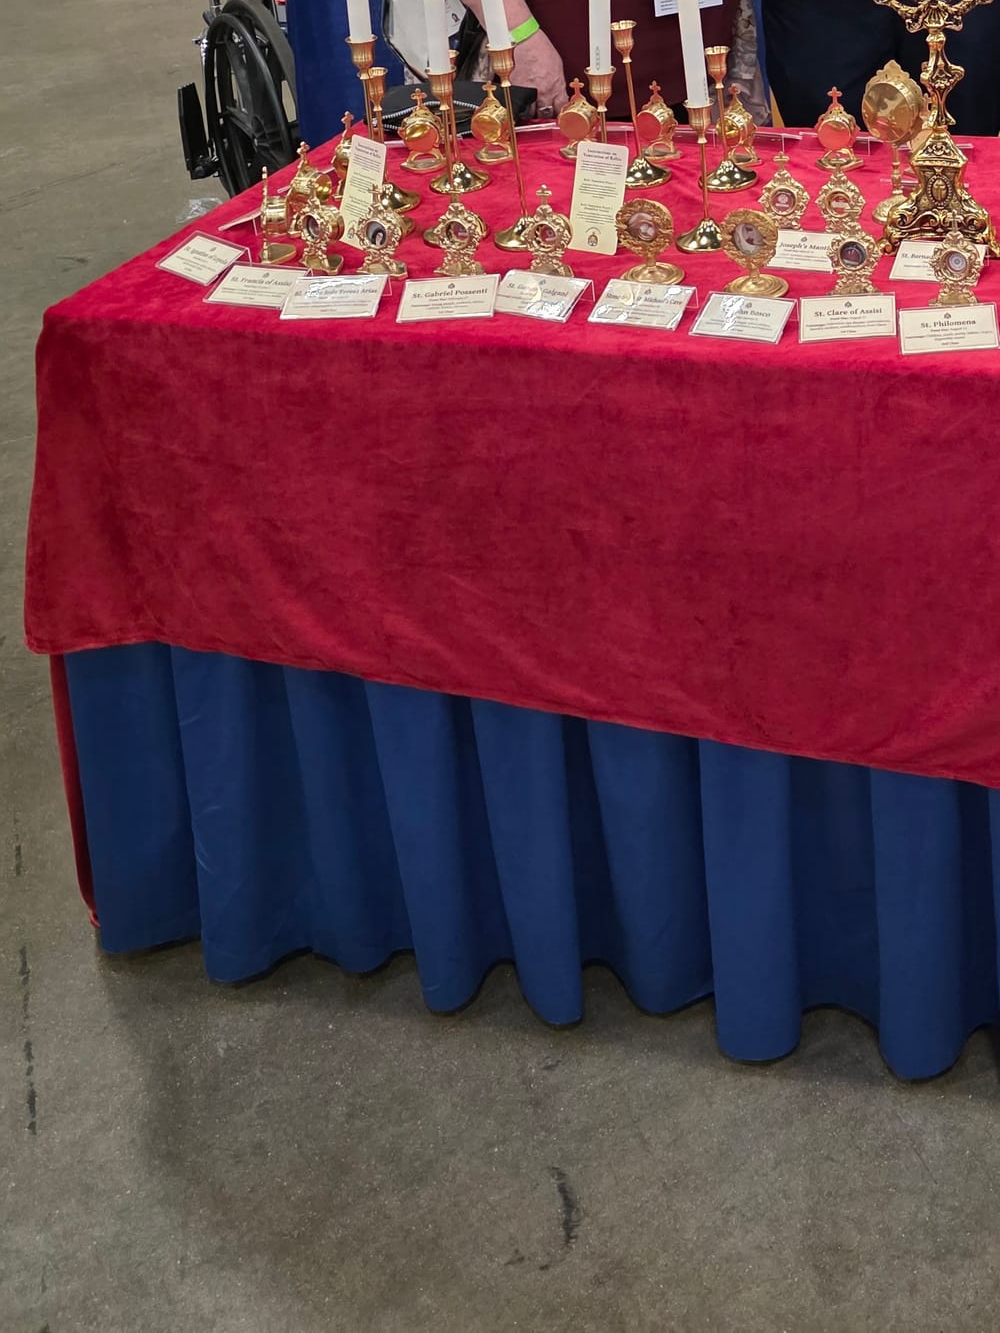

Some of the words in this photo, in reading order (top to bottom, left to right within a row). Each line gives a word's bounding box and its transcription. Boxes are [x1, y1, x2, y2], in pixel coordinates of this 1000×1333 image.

[425, 289, 453, 298] Gabriel
[455, 287, 488, 296] Possenti
[933, 319, 977, 328] Philomena
